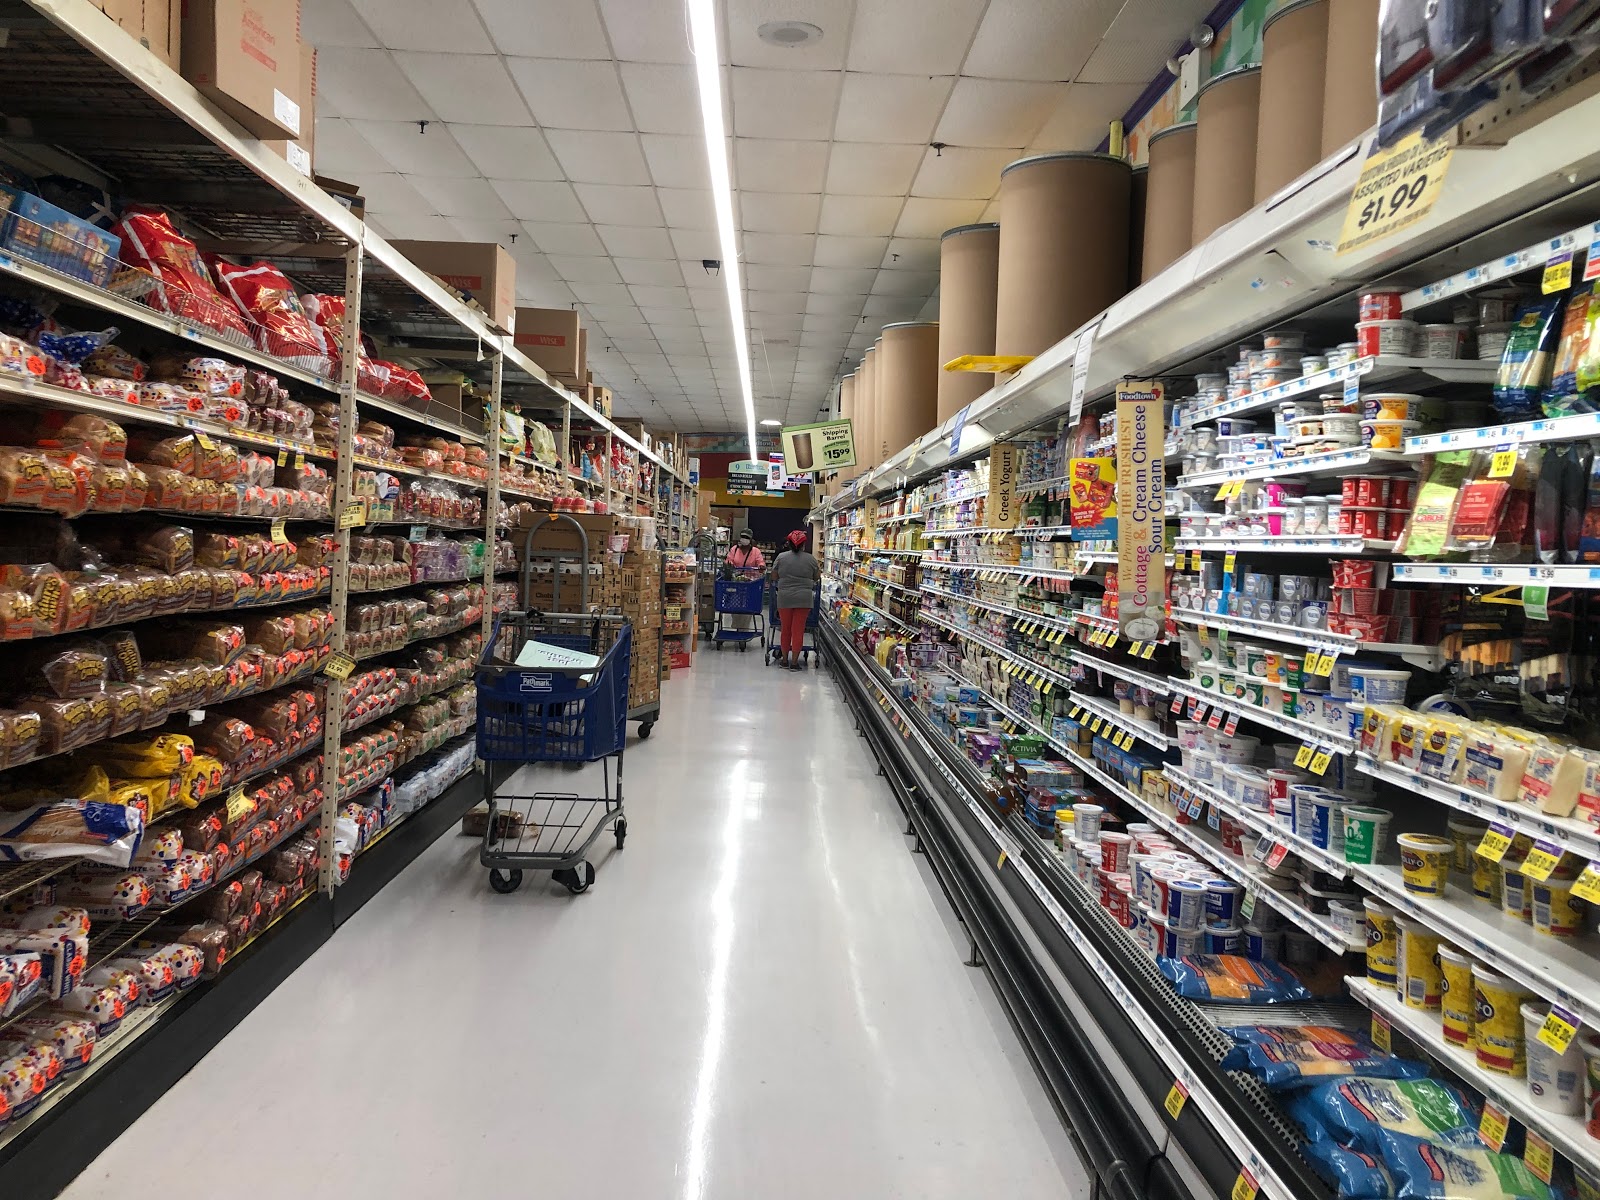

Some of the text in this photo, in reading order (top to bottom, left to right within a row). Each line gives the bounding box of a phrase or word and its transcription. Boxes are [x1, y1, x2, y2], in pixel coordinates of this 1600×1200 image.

[1353, 168, 1401, 201] ASSORTED
[1358, 174, 1428, 230] $1.99
[1119, 391, 1157, 400] Foodtown
[822, 429, 848, 437] Shipping
[1121, 417, 1132, 486] FRESHEST
[998, 450, 1013, 522] Greek Yogurt
[1121, 489, 1132, 517] THE
[1131, 404, 1151, 607] Cottage & Cream Cheese
[1148, 459, 1163, 553] Sour Cream
[522, 677, 550, 687] Pathmark
[1010, 745, 1037, 753] ACTIVIA
